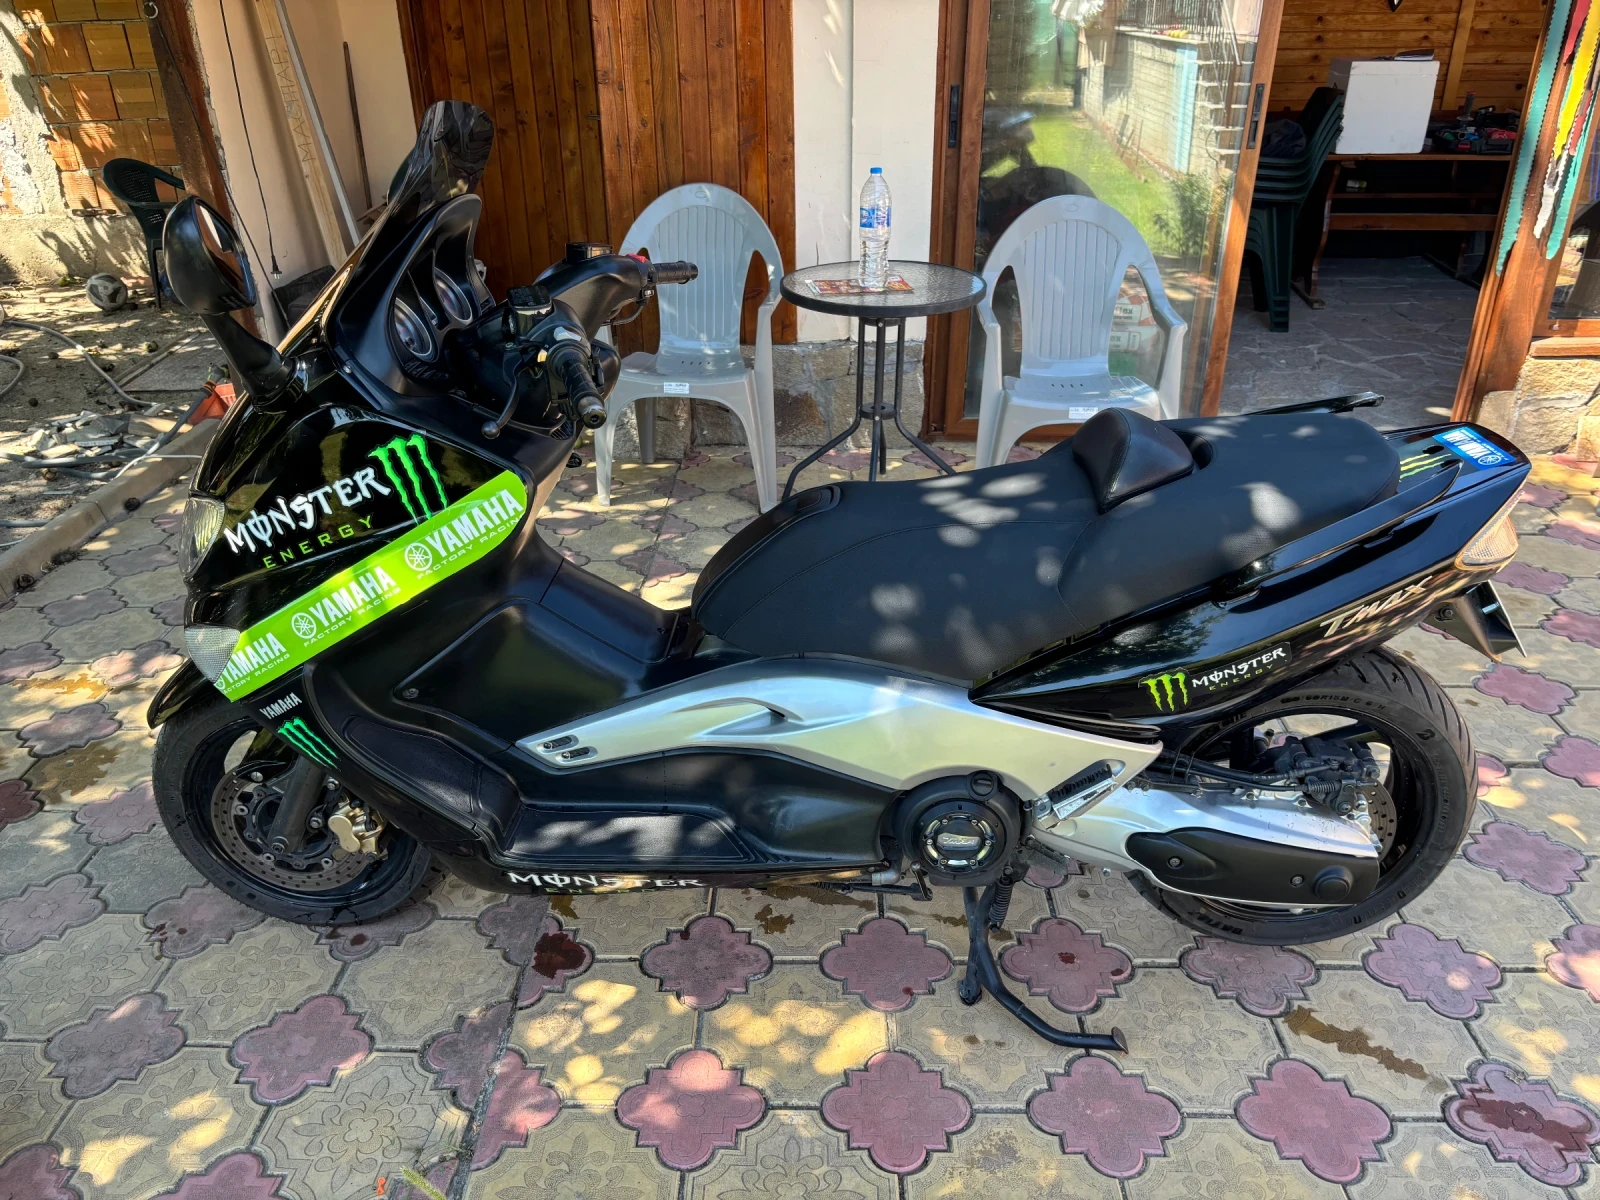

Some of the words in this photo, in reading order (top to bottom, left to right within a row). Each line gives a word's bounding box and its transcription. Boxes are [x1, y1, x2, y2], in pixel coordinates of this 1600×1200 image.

[223, 466, 392, 554] MONSTER
[425, 489, 524, 558] YAMAHA
[263, 515, 373, 569] ENERGY
[417, 544, 473, 580] FACTORY
[480, 518, 520, 544] RACIN
[303, 615, 352, 648] FACTORY
[357, 587, 401, 615] RACING
[308, 566, 397, 627] YAMAHA
[223, 676, 251, 695] ACTORY
[254, 653, 290, 677] RACING
[1191, 647, 1287, 688] MONSTER
[1209, 664, 1273, 691] ENERGY
[259, 692, 303, 720] YAMAHA
[507, 872, 705, 888] MONSTER
